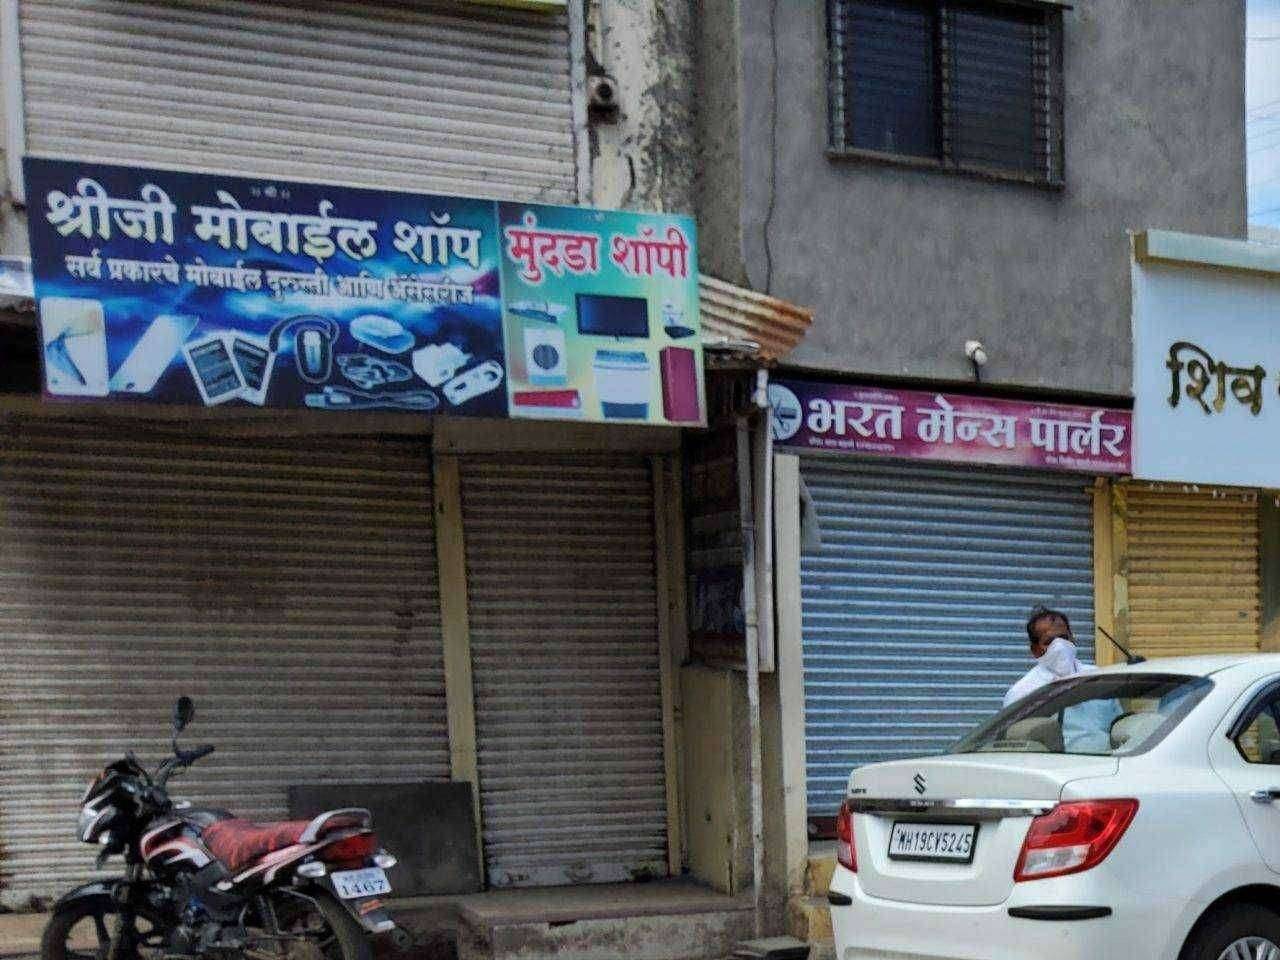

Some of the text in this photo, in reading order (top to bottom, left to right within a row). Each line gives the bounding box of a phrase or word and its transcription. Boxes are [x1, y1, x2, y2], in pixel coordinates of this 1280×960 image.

[46, 178, 482, 268] श्रीजी मोबाईल शॉप
[505, 213, 690, 283] मुंदडा शॉपी
[1166, 341, 1267, 416] शिव
[807, 394, 1126, 457] भरत मेन्स पार्लर
[897, 825, 971, 854] MH19CY5245
